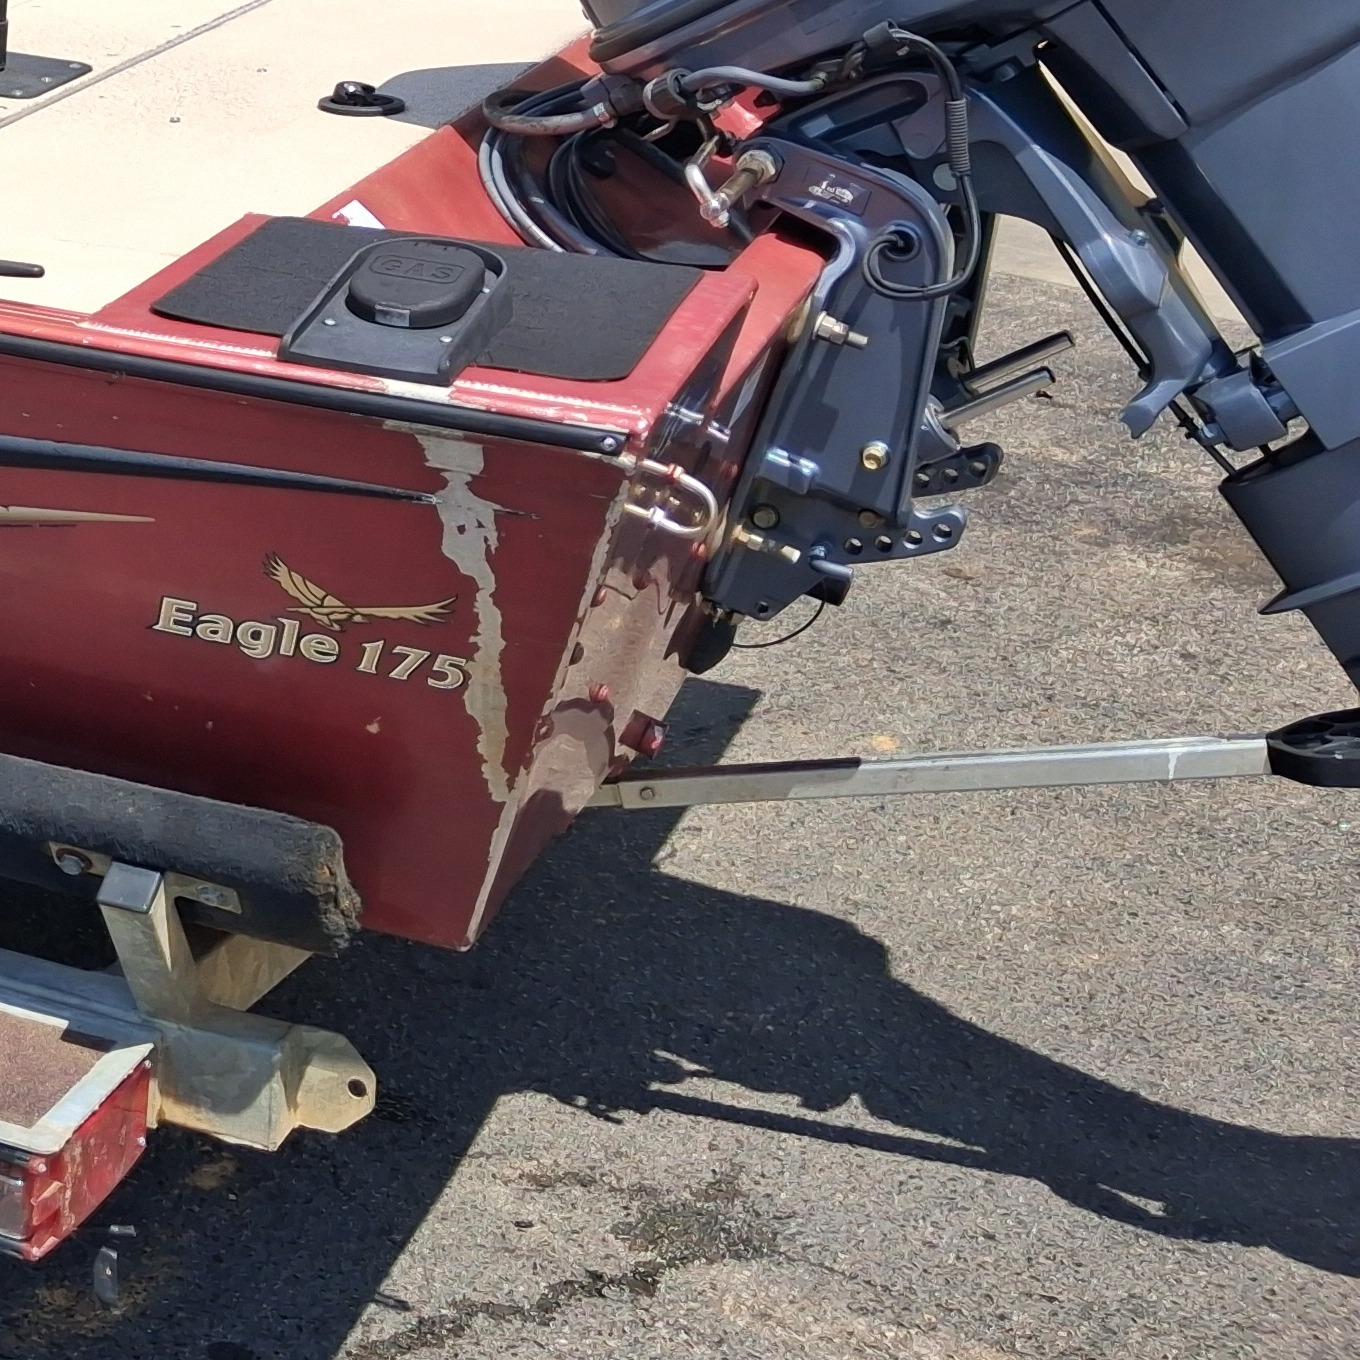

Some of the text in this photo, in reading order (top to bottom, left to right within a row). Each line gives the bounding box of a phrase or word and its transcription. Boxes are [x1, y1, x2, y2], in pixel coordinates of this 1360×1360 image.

[380, 257, 457, 280] GAS
[148, 595, 469, 690] Eagle 175
